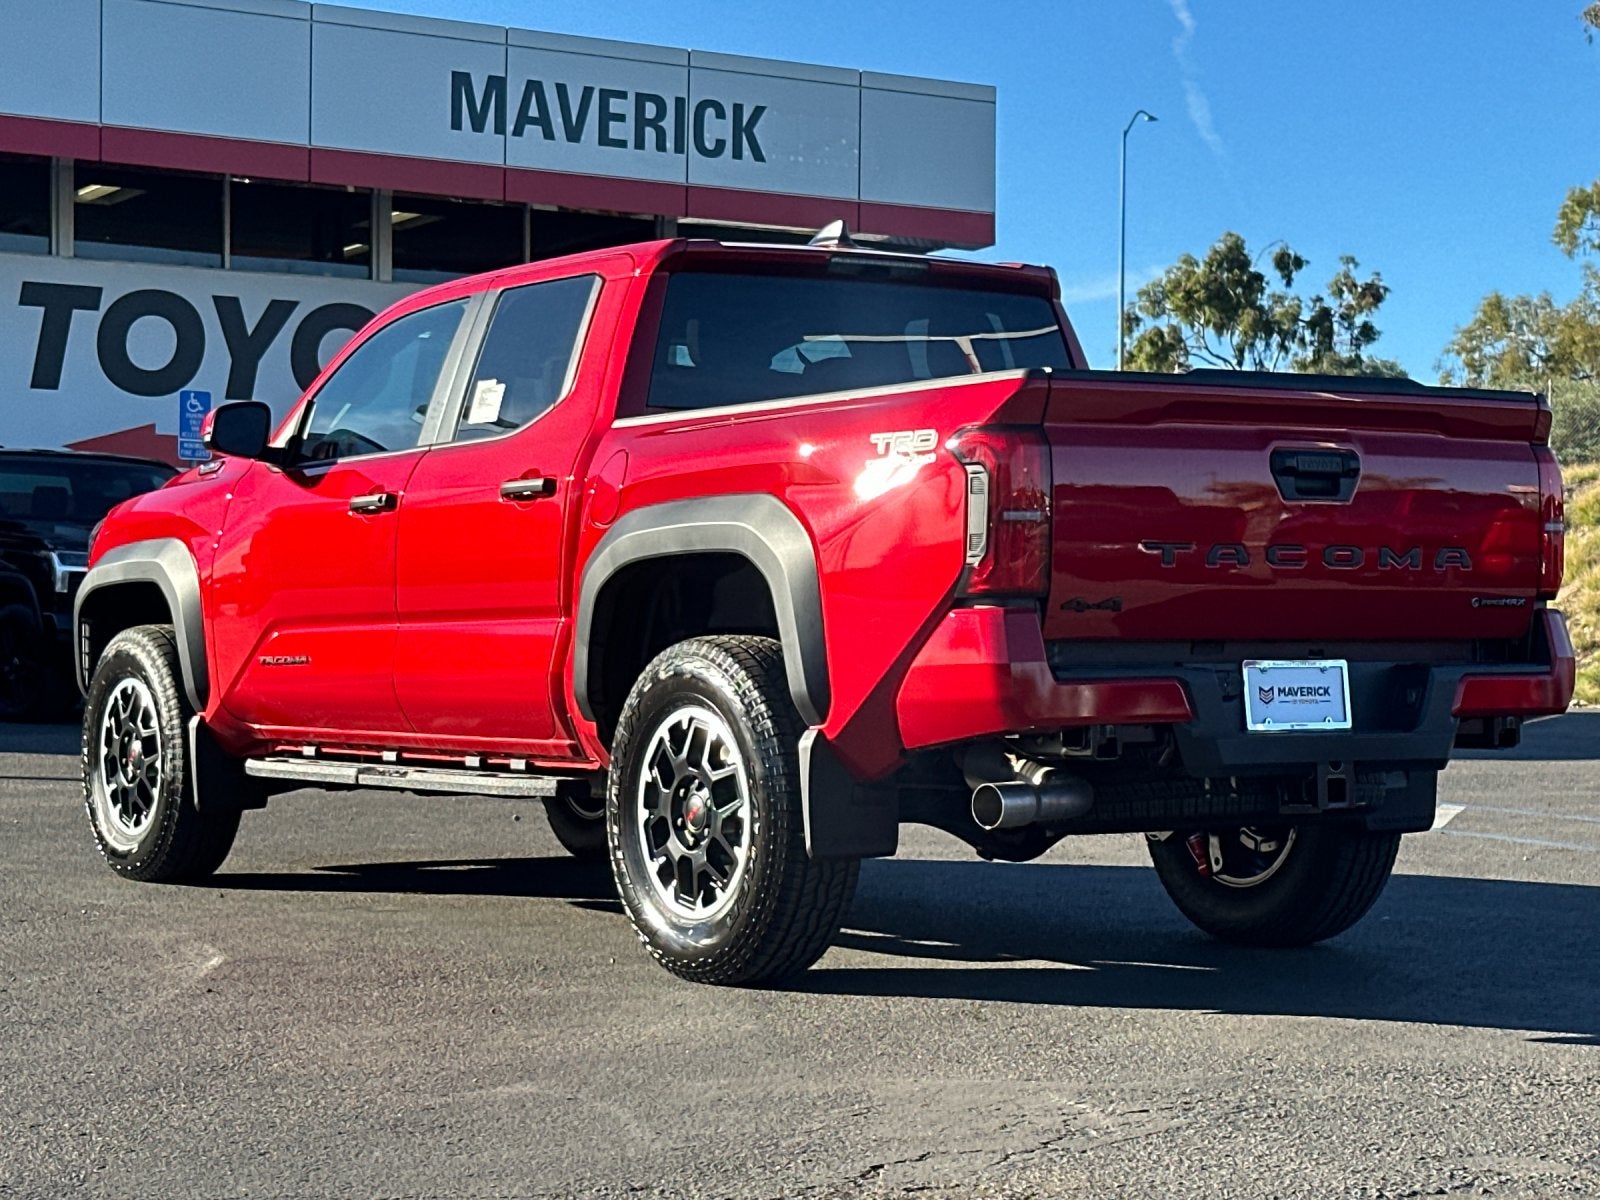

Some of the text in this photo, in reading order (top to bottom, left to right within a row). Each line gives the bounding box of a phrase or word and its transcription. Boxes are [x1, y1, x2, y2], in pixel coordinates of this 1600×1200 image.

[450, 71, 767, 163] MAVERICK
[1138, 540, 1473, 571] TACOMA
[1278, 686, 1331, 697] MAVERICK
